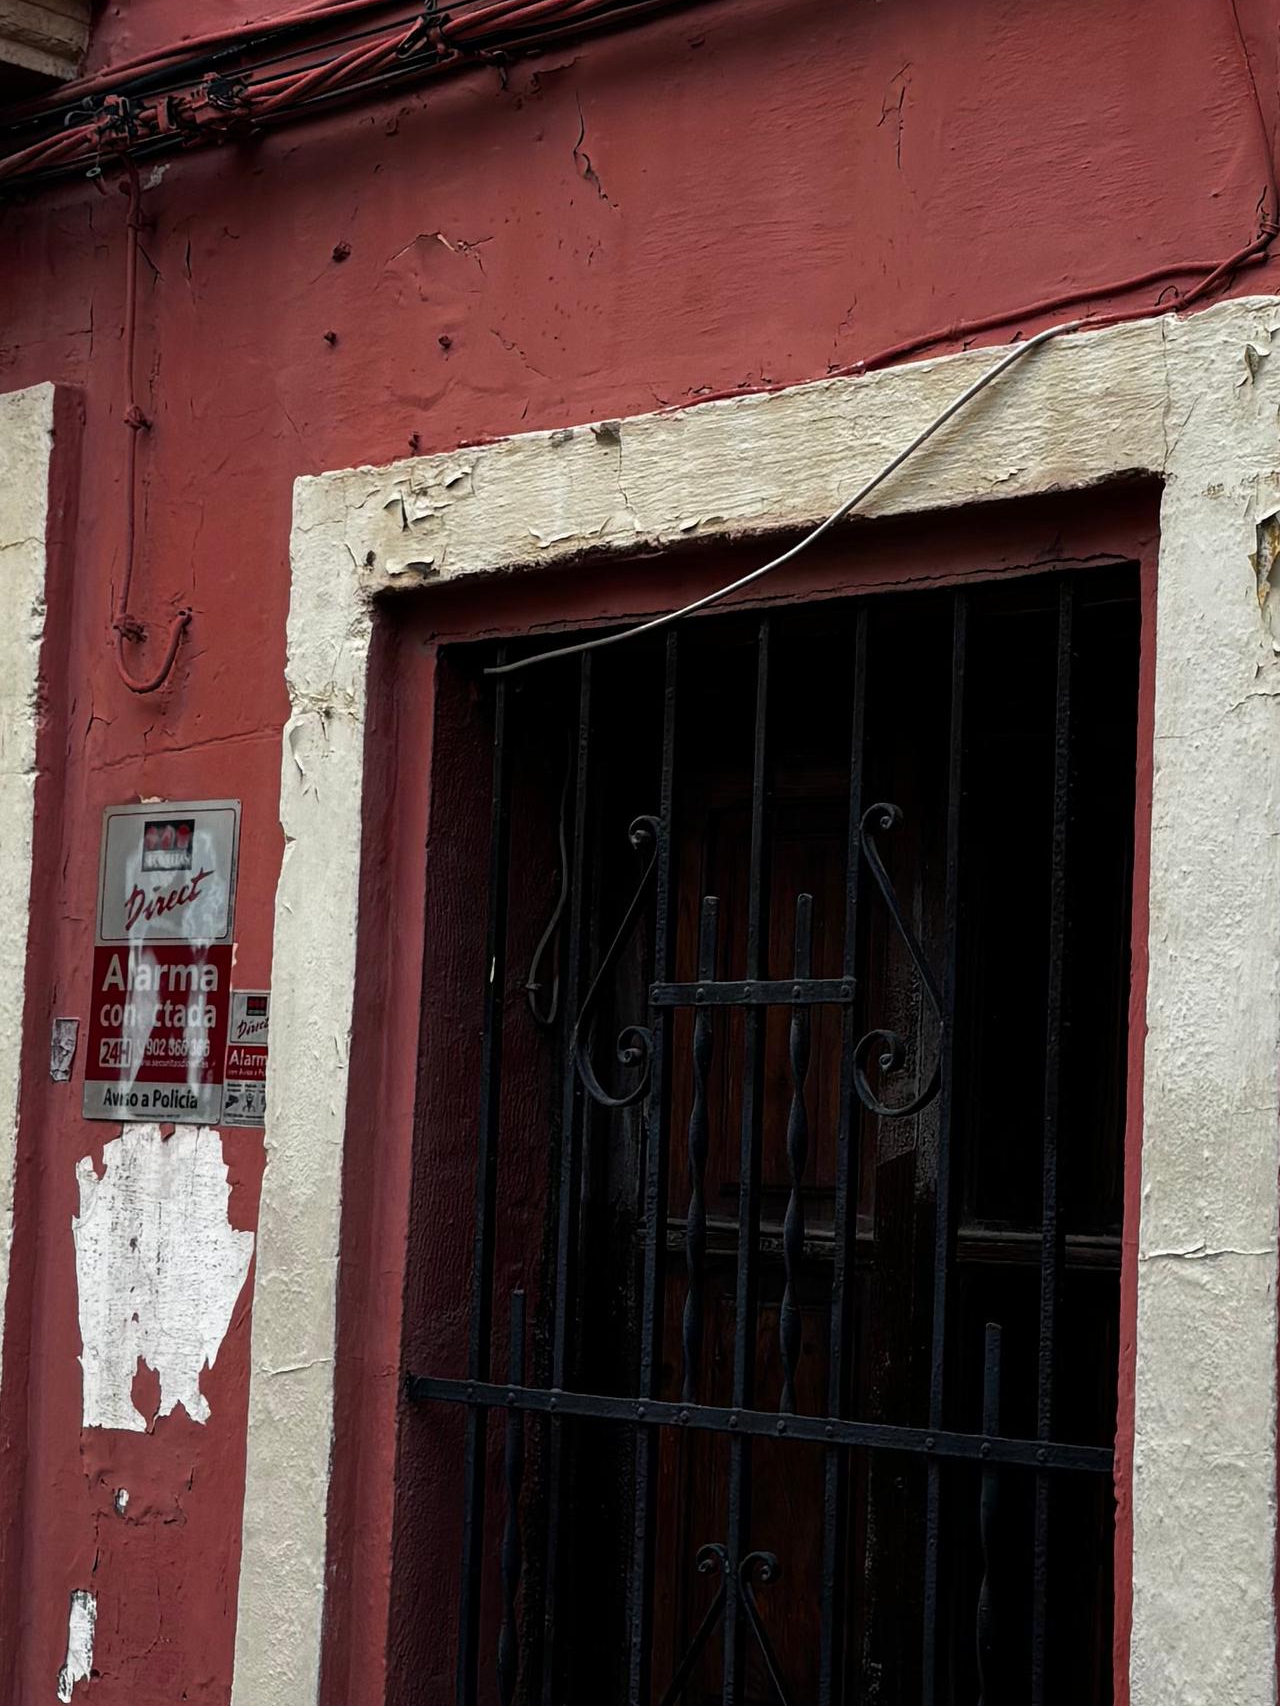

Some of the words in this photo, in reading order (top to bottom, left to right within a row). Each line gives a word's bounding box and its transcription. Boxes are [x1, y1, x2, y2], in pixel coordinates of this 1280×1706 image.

[124, 867, 215, 931] Direct
[102, 951, 219, 992] Alarma
[100, 995, 217, 1027] conctada
[237, 1016, 269, 1039] Direct
[101, 1040, 130, 1064] 24H
[146, 1038, 166, 1056] 902
[228, 1049, 267, 1067] Alarm
[141, 1094, 149, 1107] a
[152, 1089, 198, 1110] Policía
